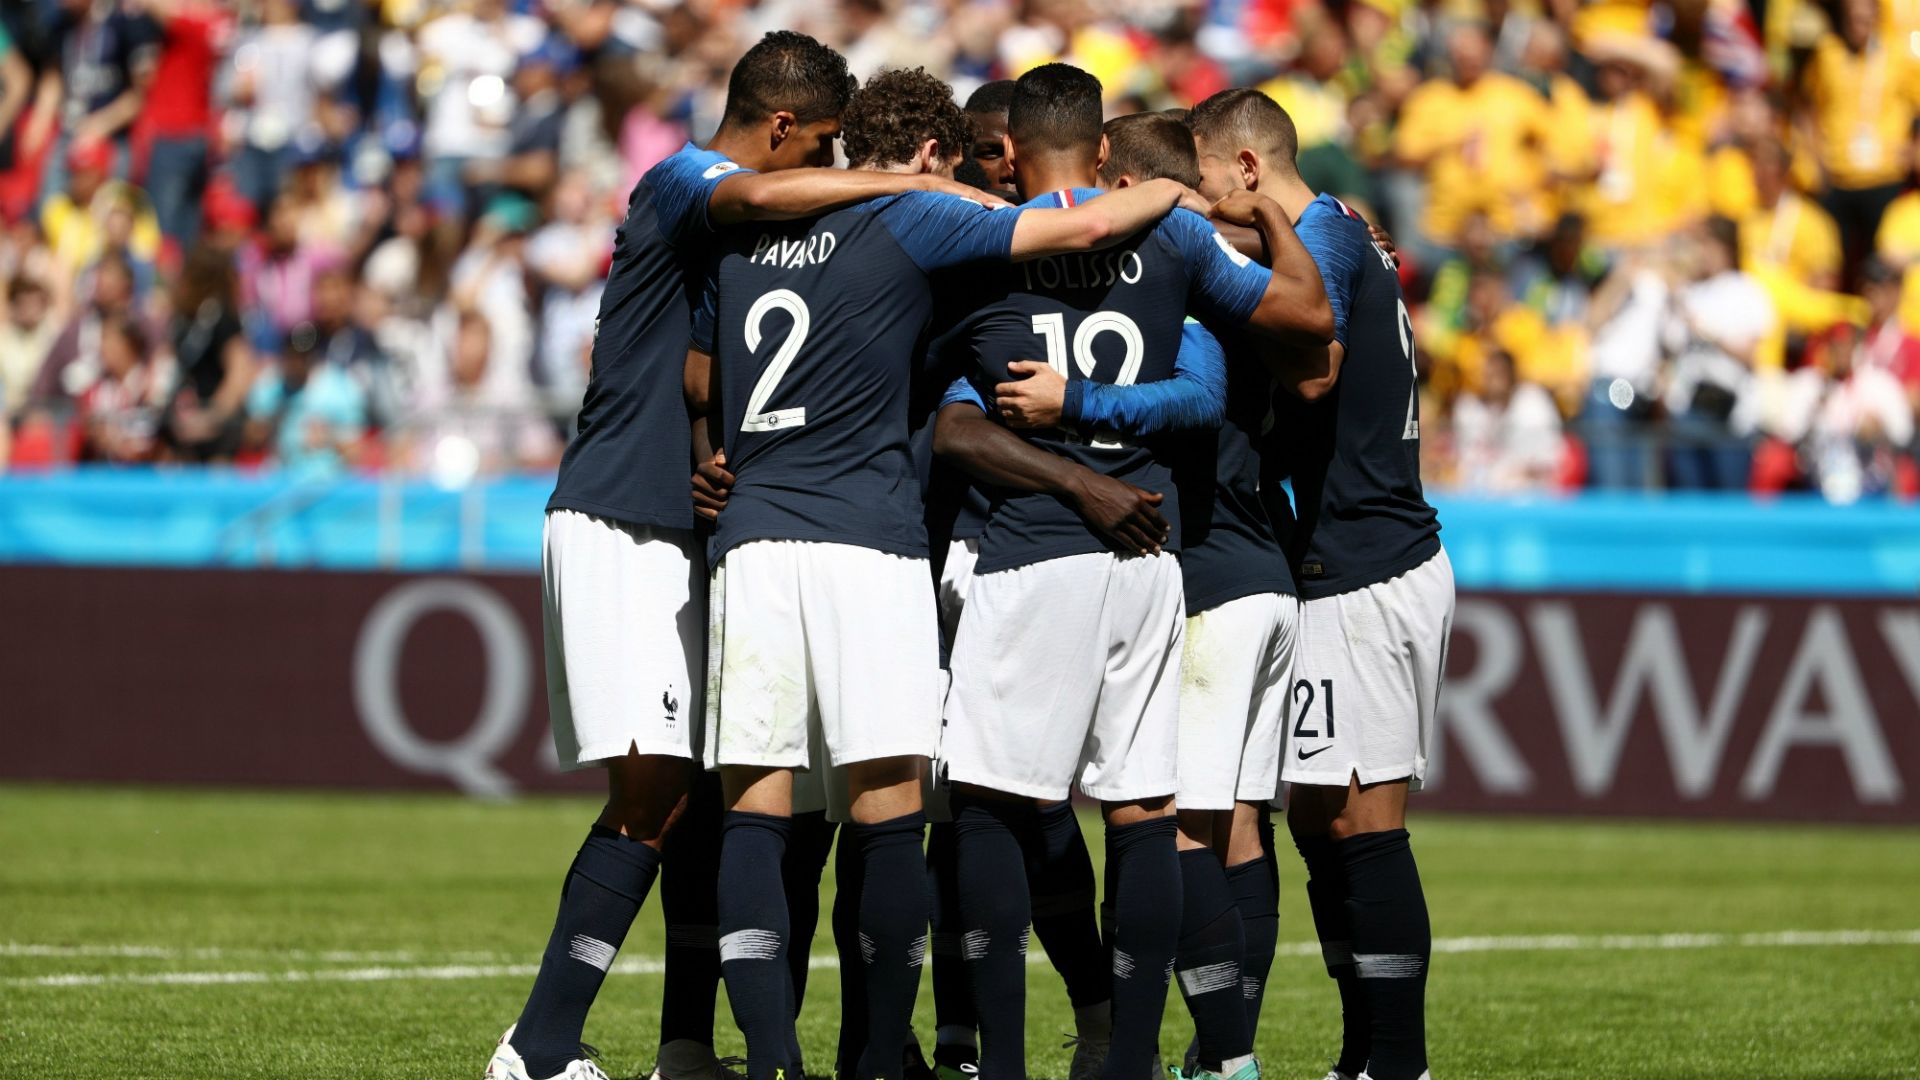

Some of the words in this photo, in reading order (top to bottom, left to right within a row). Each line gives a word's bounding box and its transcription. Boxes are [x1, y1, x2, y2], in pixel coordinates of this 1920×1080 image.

[750, 231, 836, 269] PAVARD
[740, 288, 810, 432] 2
[1293, 679, 1335, 738] 21
